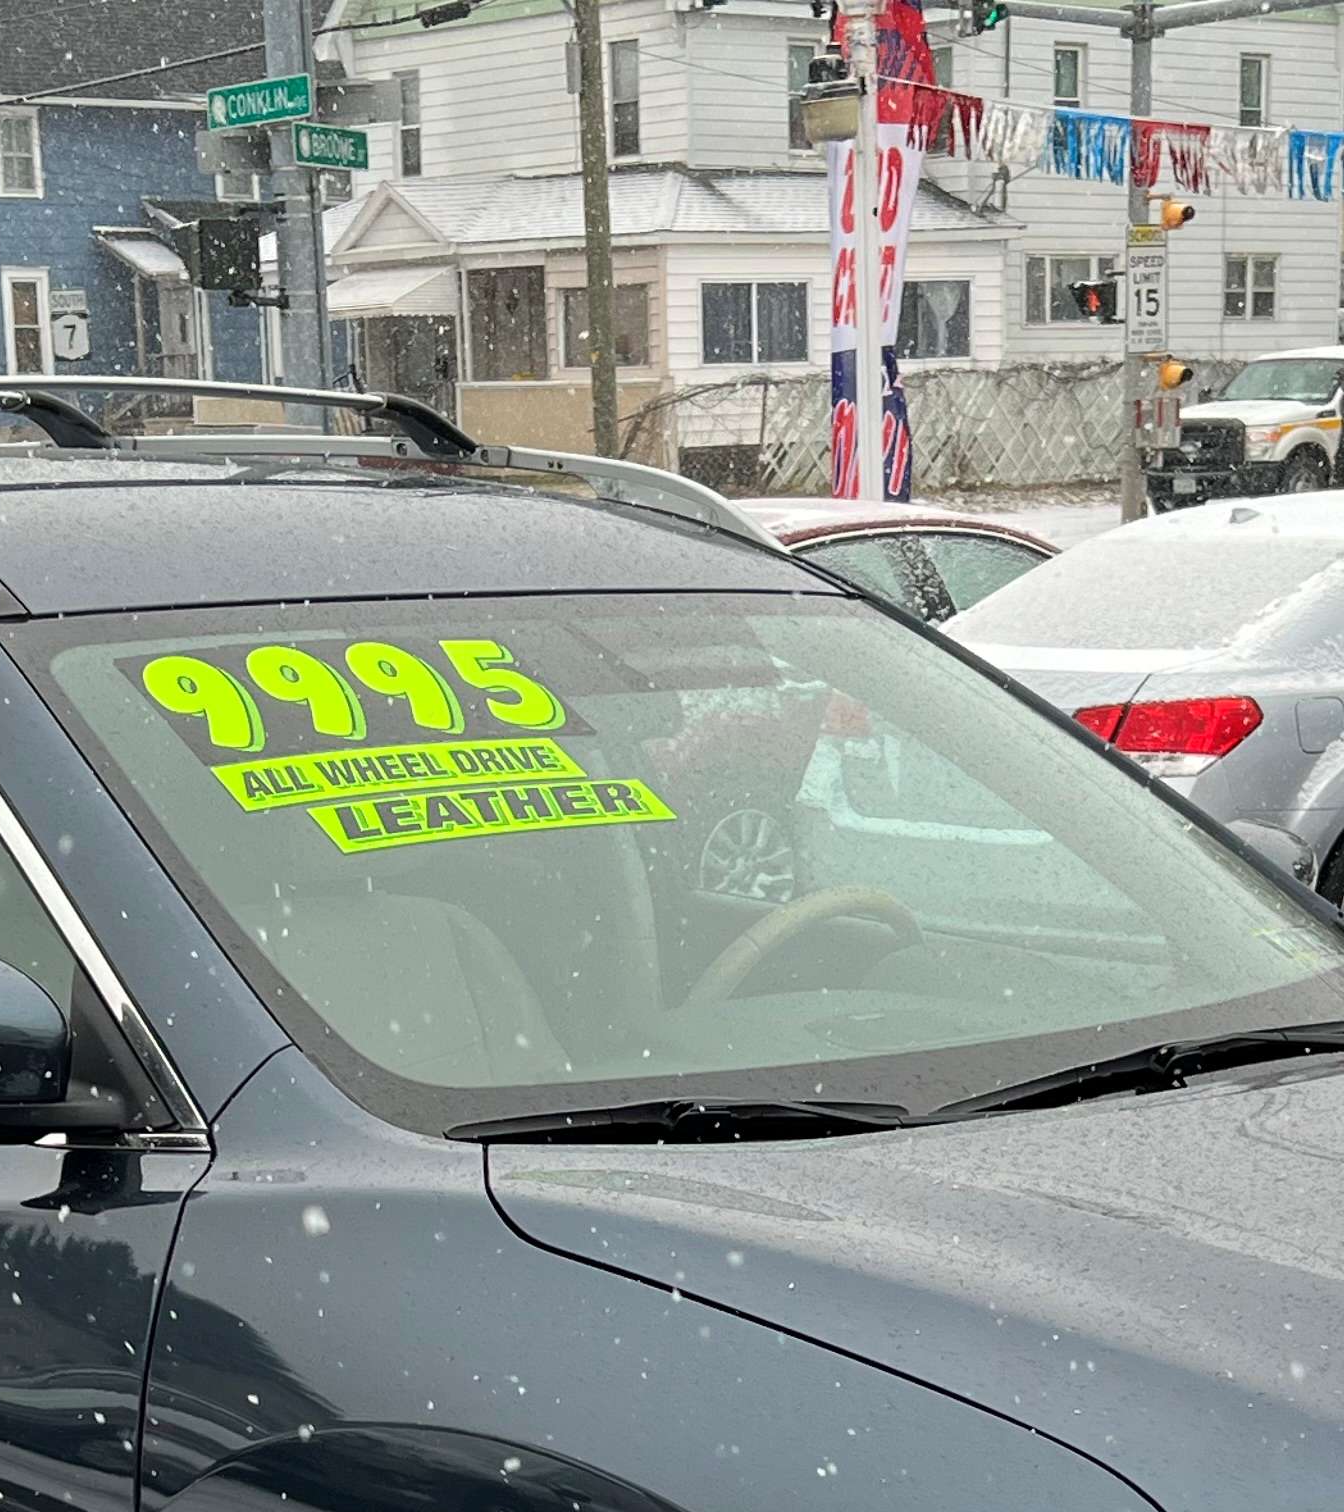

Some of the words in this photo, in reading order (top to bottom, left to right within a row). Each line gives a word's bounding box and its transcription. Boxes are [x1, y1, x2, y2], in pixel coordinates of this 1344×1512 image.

[227, 85, 288, 119] CONKLIN
[1130, 255, 1164, 269] SPEED
[1133, 271, 1161, 285] LIMIT
[1134, 287, 1161, 317] 15
[63, 324, 76, 349] 7
[142, 640, 565, 752] 9995
[243, 764, 319, 799] ALL
[314, 751, 447, 786] WHEEL
[457, 743, 565, 777] DRIVE
[337, 780, 644, 843] LEATHER
